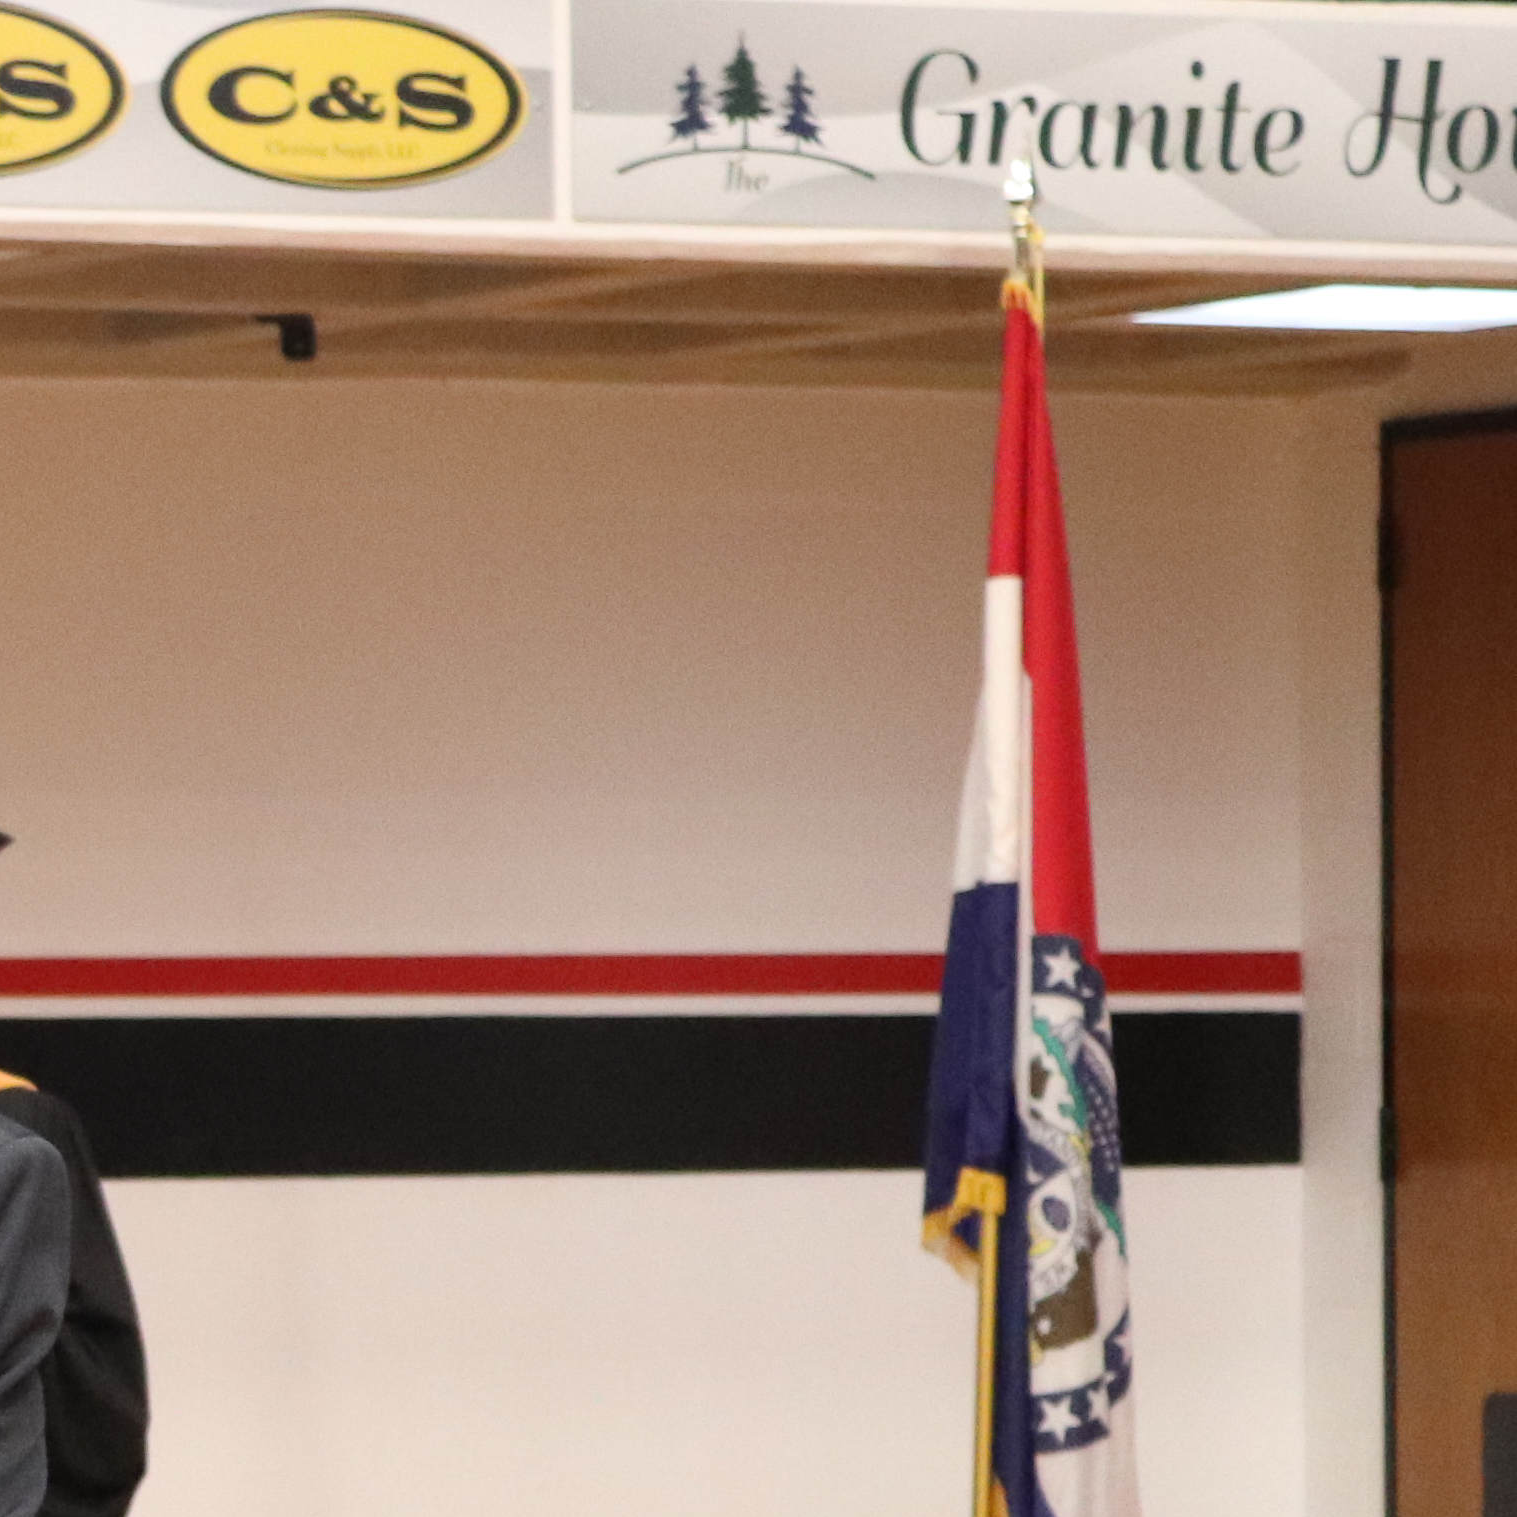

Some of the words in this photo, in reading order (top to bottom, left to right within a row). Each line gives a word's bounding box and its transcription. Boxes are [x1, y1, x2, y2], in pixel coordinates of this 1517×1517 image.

[208, 65, 475, 132] C&S
[900, 48, 1305, 176] Granite
[1344, 56, 1517, 204] Ho
